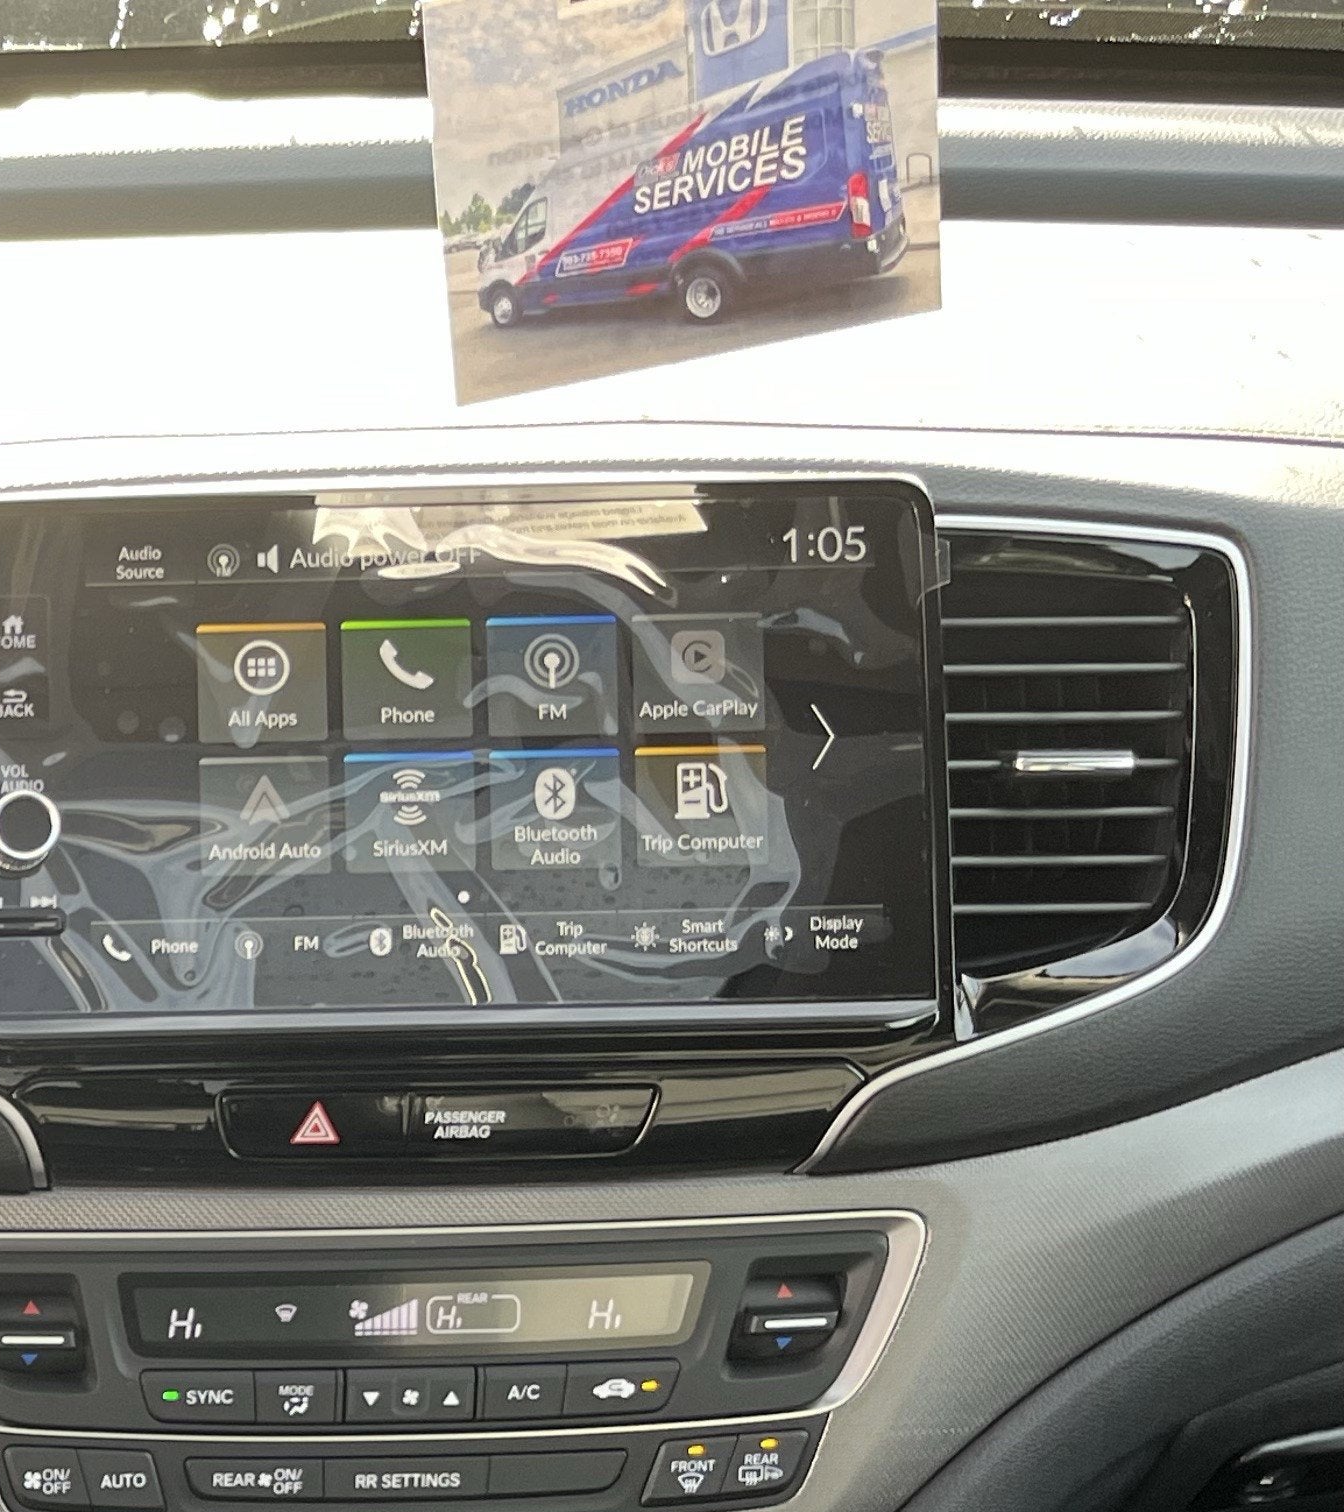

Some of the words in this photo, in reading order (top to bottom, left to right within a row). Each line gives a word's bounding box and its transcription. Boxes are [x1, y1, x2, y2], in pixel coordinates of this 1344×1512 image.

[564, 59, 685, 117] HONDA
[682, 114, 806, 174] MOBILE
[634, 145, 807, 215] SERVICES
[782, 525, 867, 563] 1:05
[118, 546, 162, 562] Audio
[289, 547, 354, 568] Audio
[361, 552, 425, 572] power
[436, 548, 483, 564] OFF
[116, 565, 164, 580] Source
[380, 706, 435, 725] Phone
[538, 703, 567, 720] FM
[639, 700, 688, 720] Apple
[693, 699, 758, 719] CarPlay
[228, 709, 252, 727] All
[256, 710, 298, 729] Apps
[1, 764, 29, 778] VOL
[1, 779, 45, 794] AUDIO
[514, 825, 598, 843] Bluetooth
[642, 834, 674, 853] Trip
[677, 832, 764, 853] Computer
[209, 842, 275, 860] Android
[279, 841, 321, 859] Auto
[373, 839, 448, 857] SiriusXM
[530, 848, 581, 865] Audio
[403, 924, 474, 940] Bluetooth
[557, 922, 583, 939] Trip
[682, 918, 724, 934] Smart
[810, 916, 863, 935] Display
[151, 939, 198, 954] Phone
[294, 936, 319, 951] FM
[535, 940, 608, 957] Computer
[669, 937, 738, 954] Shortcuts
[815, 934, 858, 950] Mode
[424, 1111, 506, 1125] PASSENGER
[433, 1125, 491, 1139] AIRBAG
[457, 1292, 488, 1304] REAR
[186, 1389, 234, 1406] SYNC
[278, 1385, 314, 1397] MODE
[507, 1384, 540, 1401] A/C
[671, 1459, 715, 1474] FRONT
[744, 1453, 779, 1467] REAR
[42, 1480, 71, 1496] OFF
[100, 1472, 147, 1489] AUTO
[212, 1472, 254, 1488] REAR
[273, 1480, 303, 1496] OFF
[355, 1474, 378, 1490] RR
[382, 1473, 461, 1490] SETTINGS
